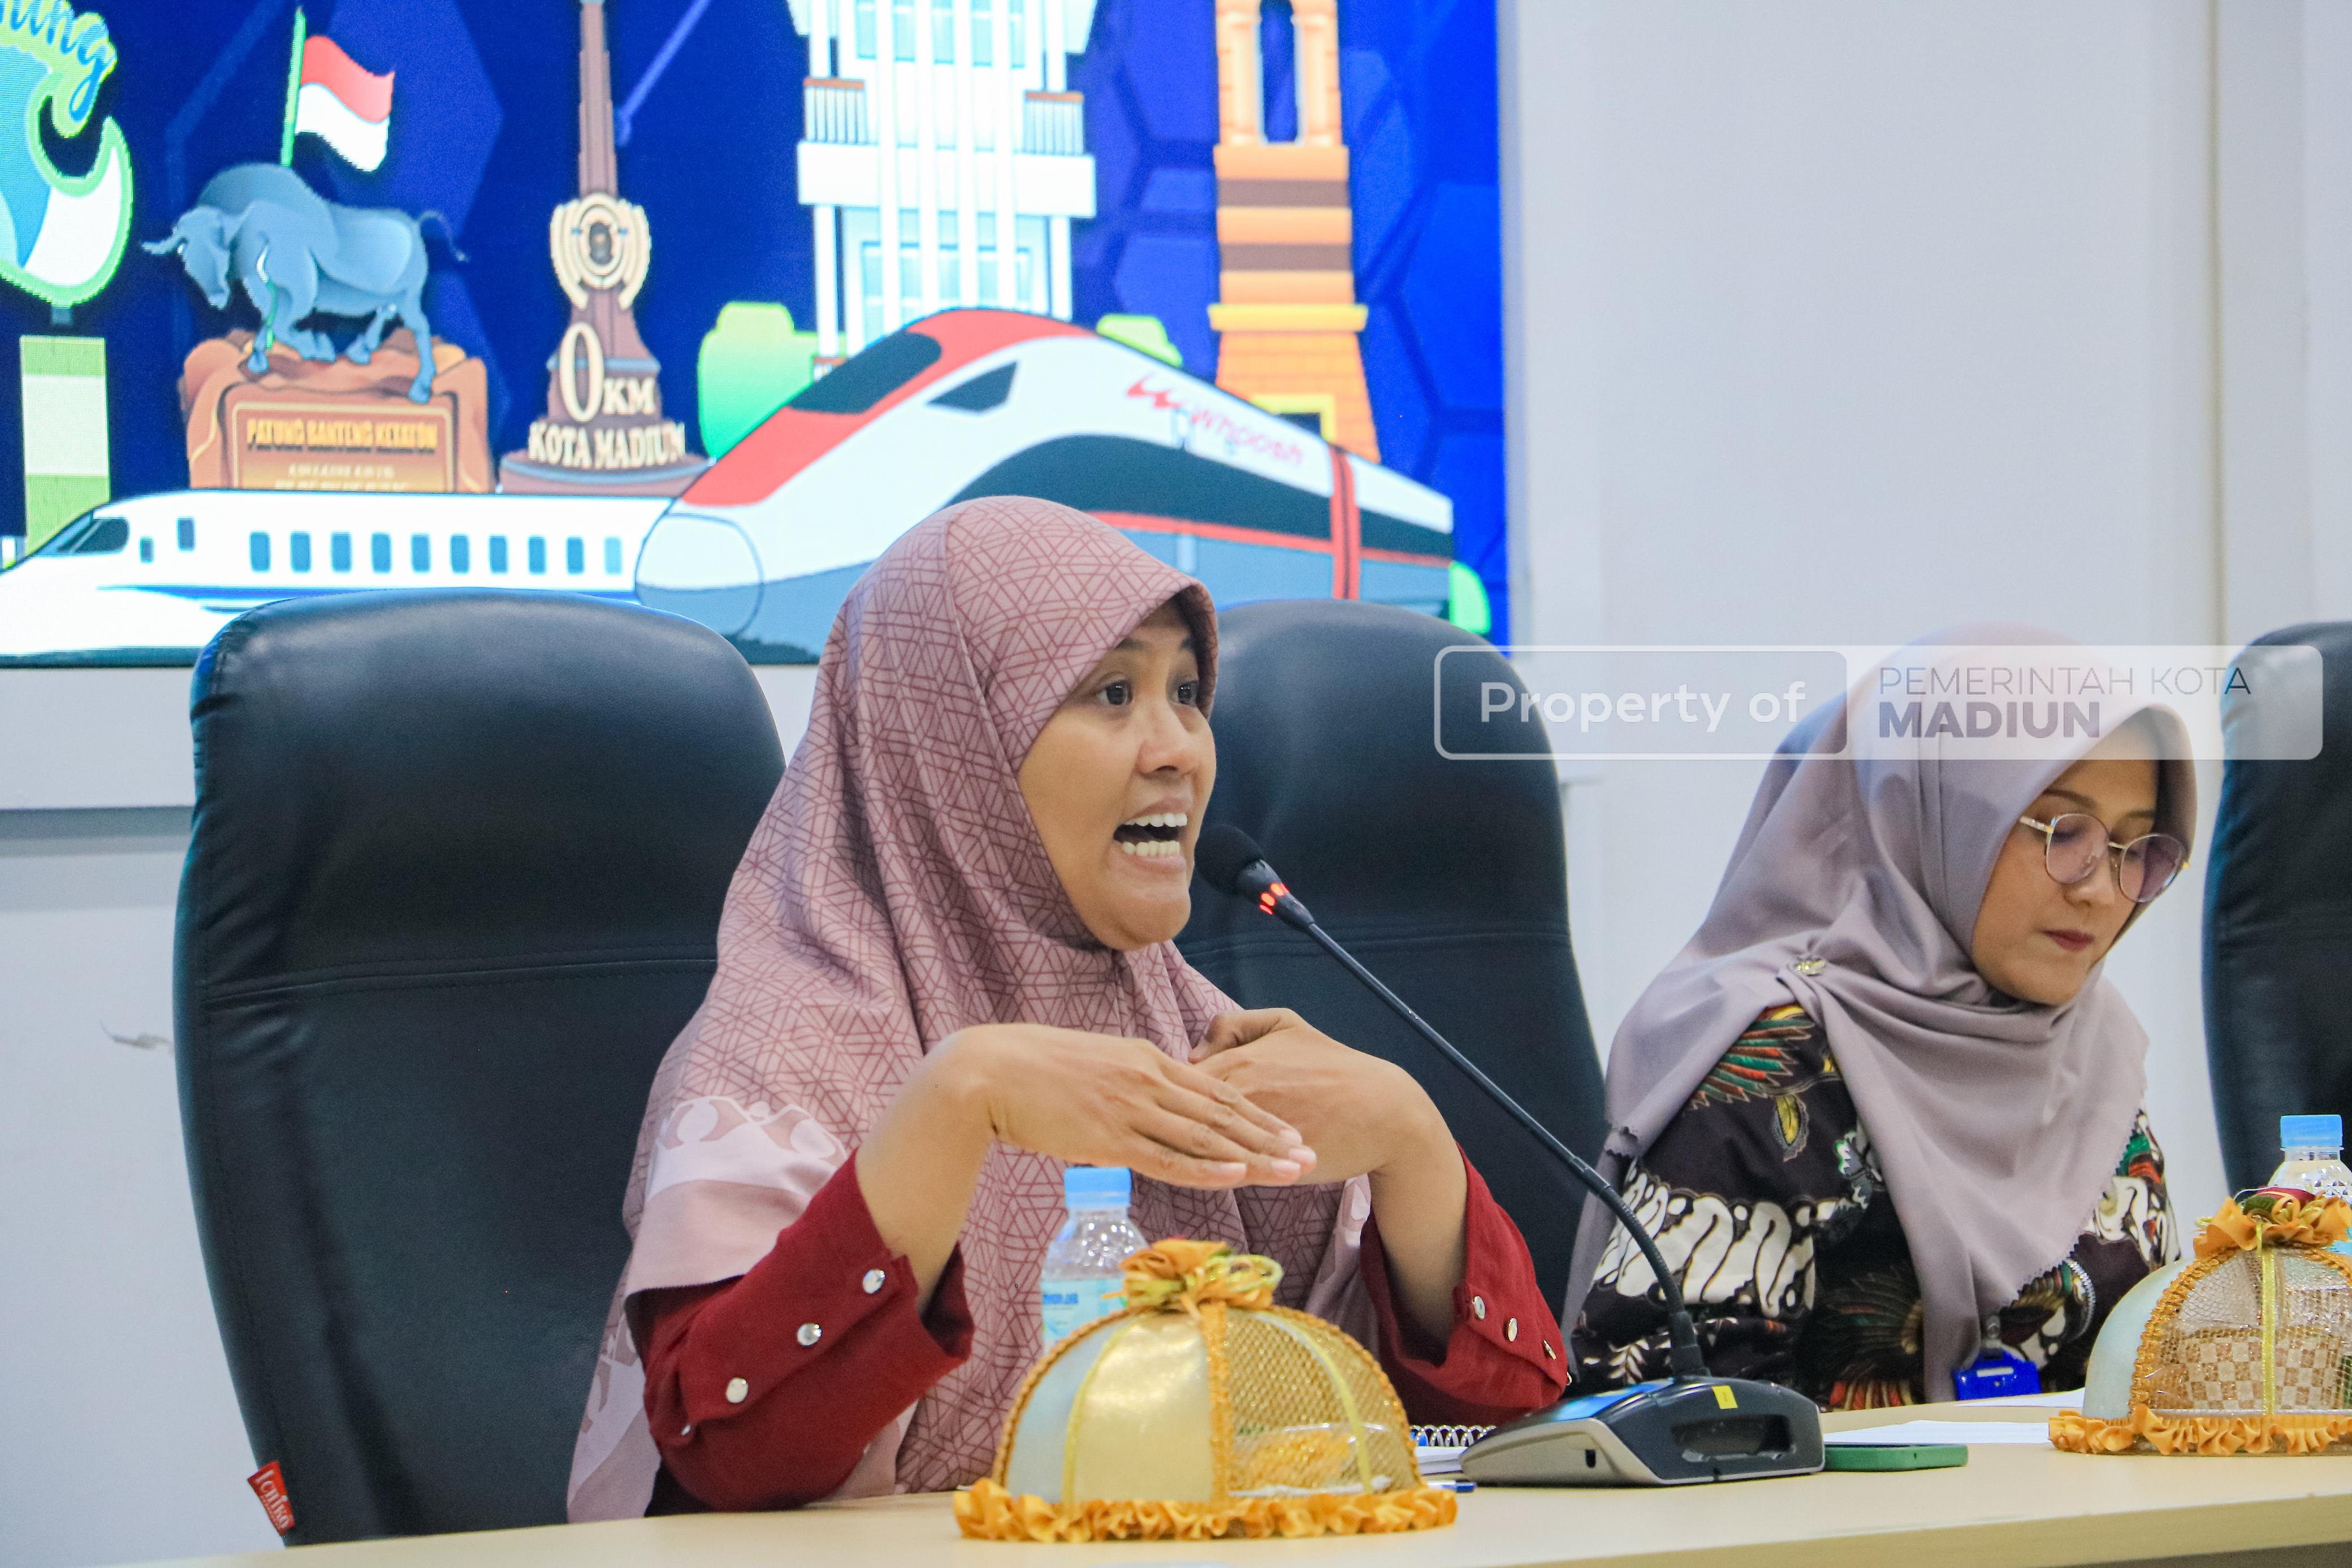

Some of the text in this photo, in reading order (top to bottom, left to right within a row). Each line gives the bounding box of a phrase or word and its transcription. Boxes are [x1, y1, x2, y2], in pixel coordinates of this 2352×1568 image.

[603, 378, 655, 414] KM
[528, 421, 686, 470] KOTA MADIUN
